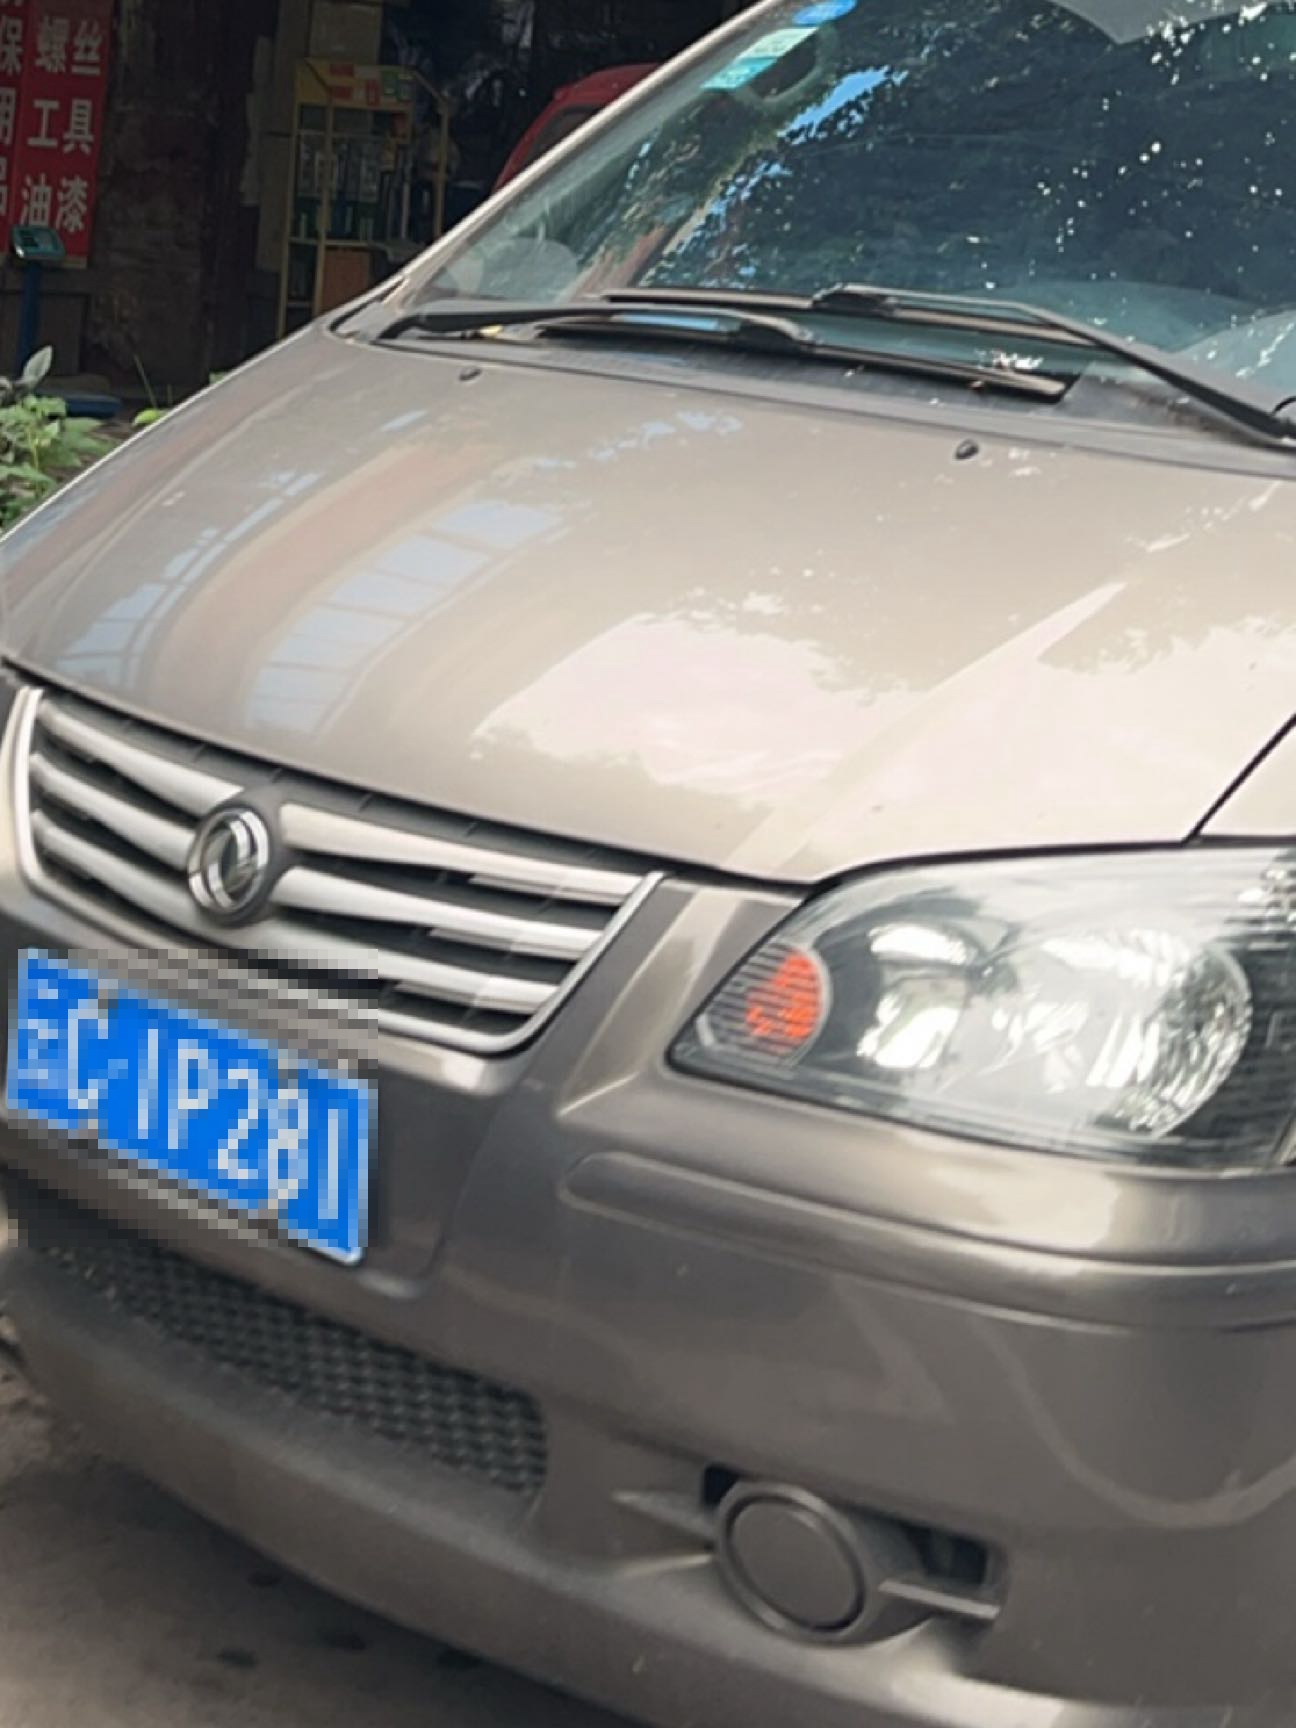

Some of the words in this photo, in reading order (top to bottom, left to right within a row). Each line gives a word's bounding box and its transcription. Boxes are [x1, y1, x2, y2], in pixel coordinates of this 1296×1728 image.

[33, 15, 102, 76] 螺丝
[26, 98, 95, 155] 工具
[19, 174, 89, 235] 油漆
